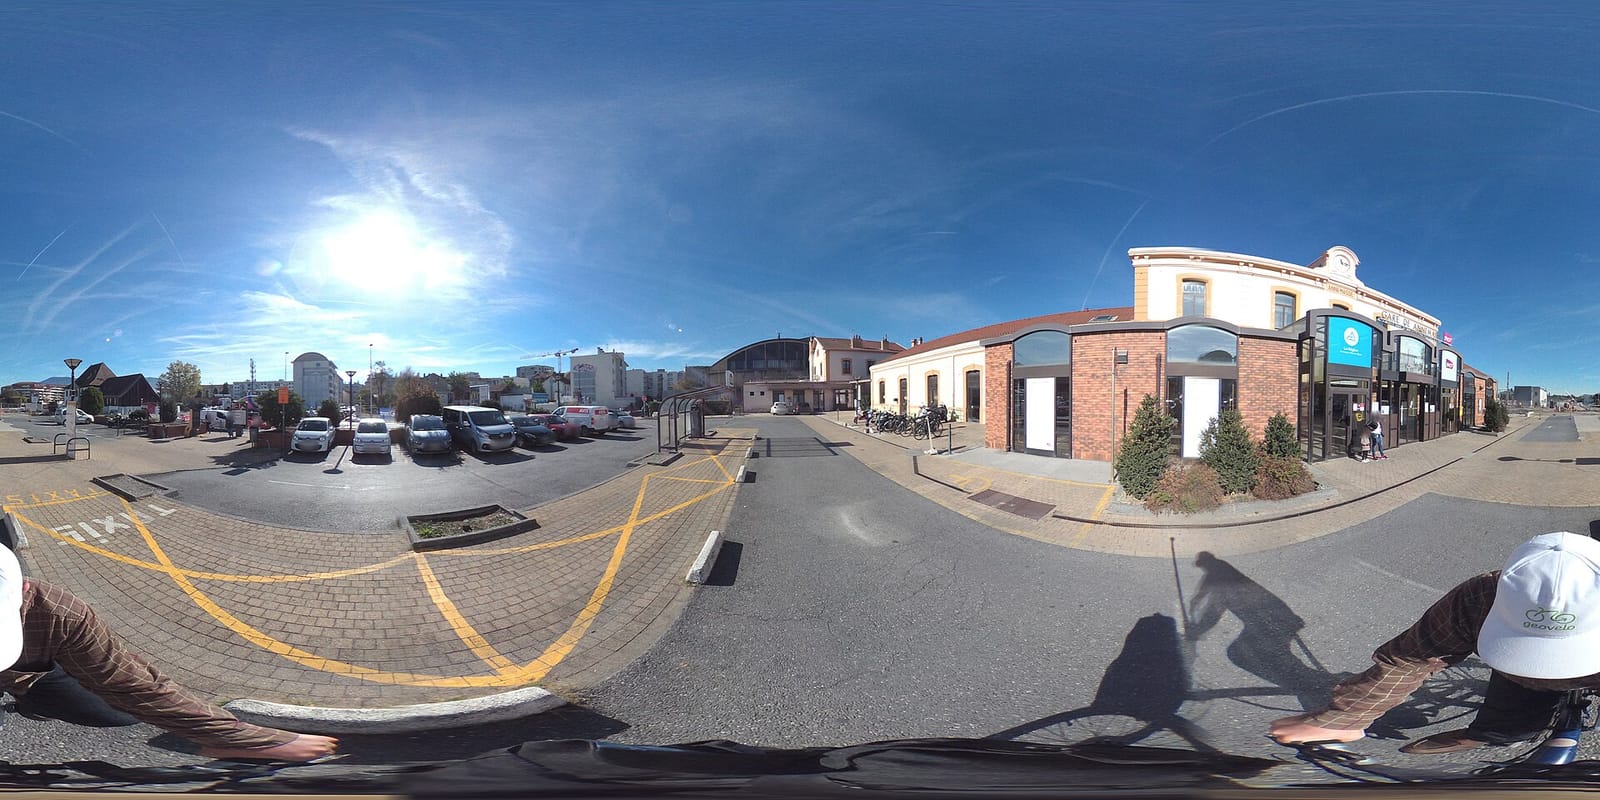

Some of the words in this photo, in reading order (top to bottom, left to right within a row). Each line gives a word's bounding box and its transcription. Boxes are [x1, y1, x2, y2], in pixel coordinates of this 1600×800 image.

[1381, 310, 1400, 324] GARE
[1403, 318, 1410, 327] DE
[1523, 621, 1576, 631] geovelo
